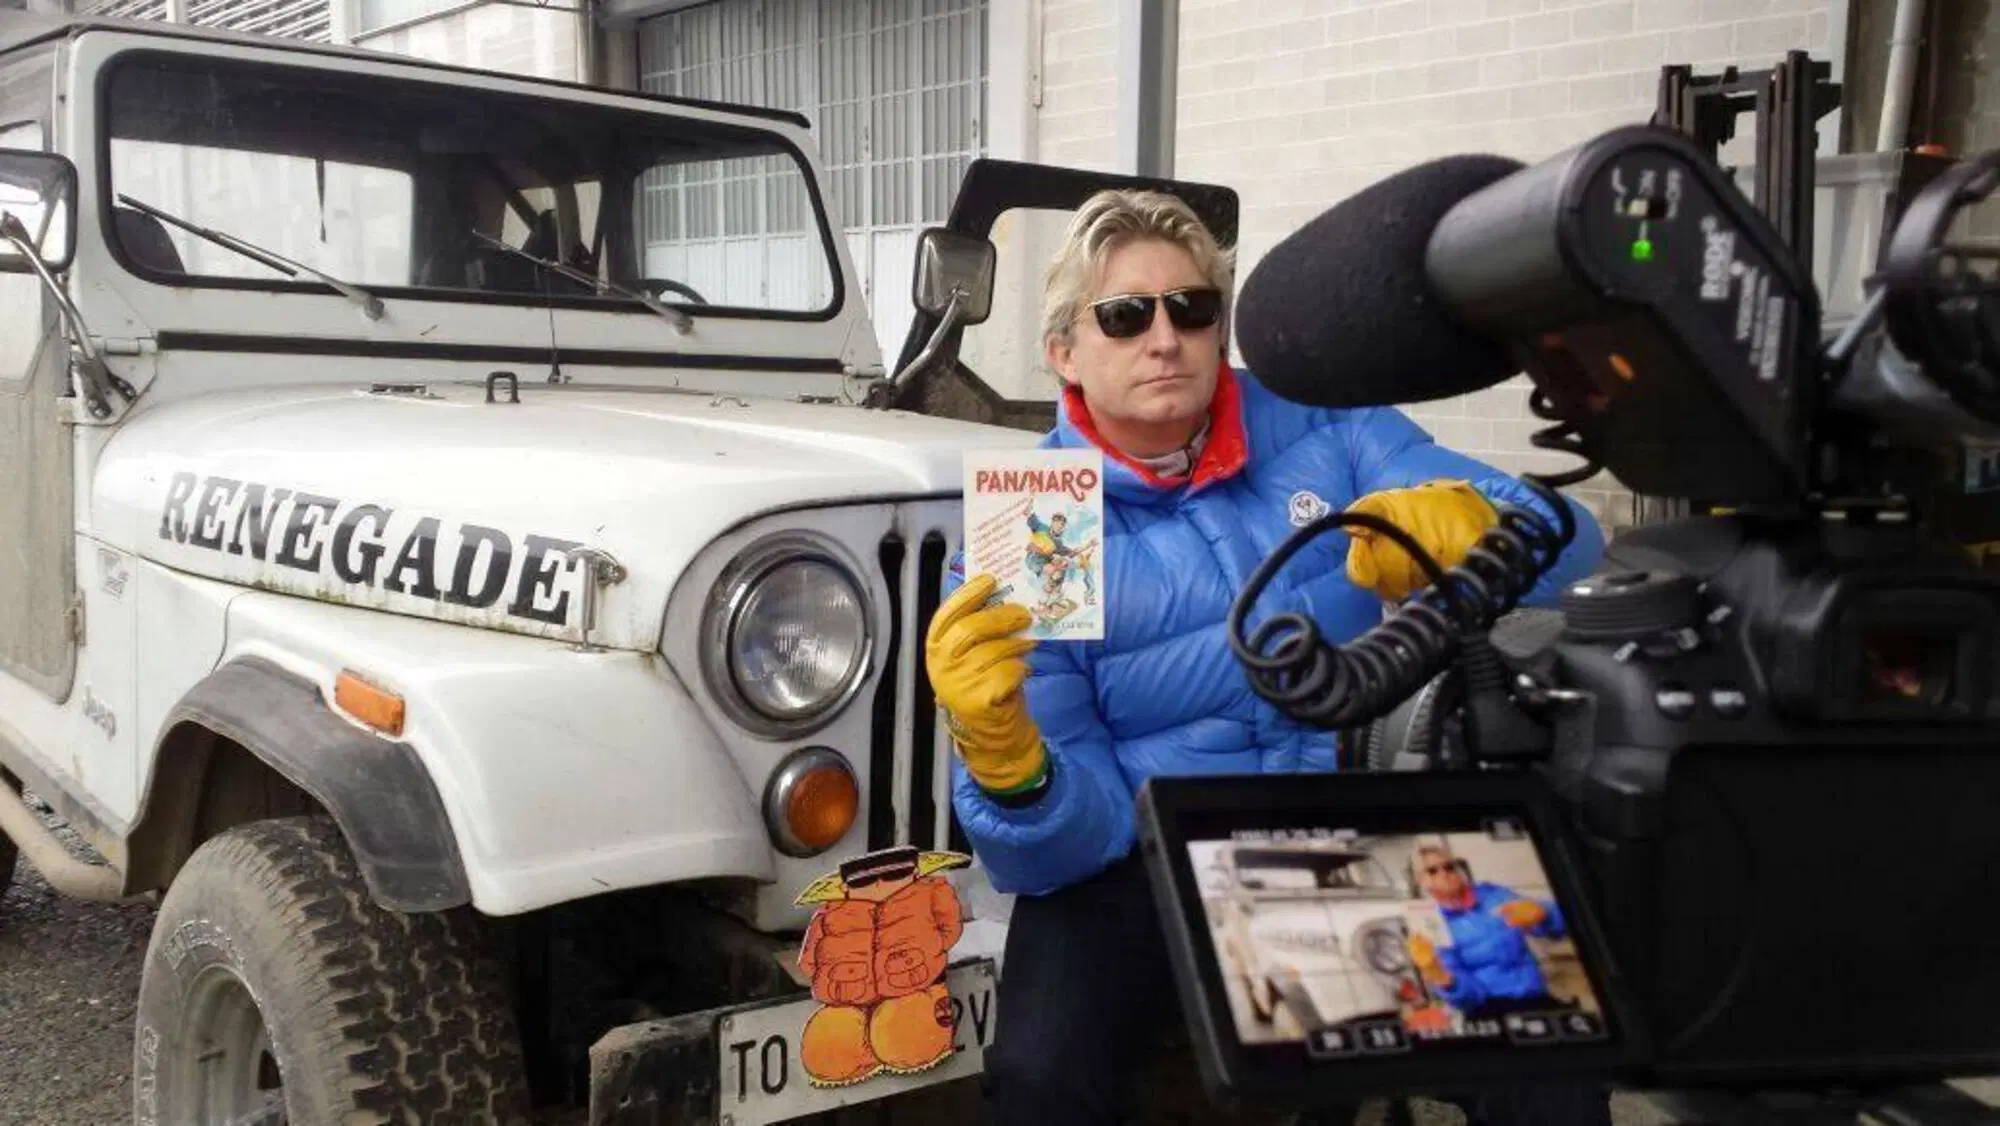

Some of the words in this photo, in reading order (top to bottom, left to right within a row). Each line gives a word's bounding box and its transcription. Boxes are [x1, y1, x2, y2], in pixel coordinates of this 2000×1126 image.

[976, 468, 1098, 502] PANINARO
[158, 470, 588, 626] RENEGADE
[731, 1033, 788, 1103] TO
